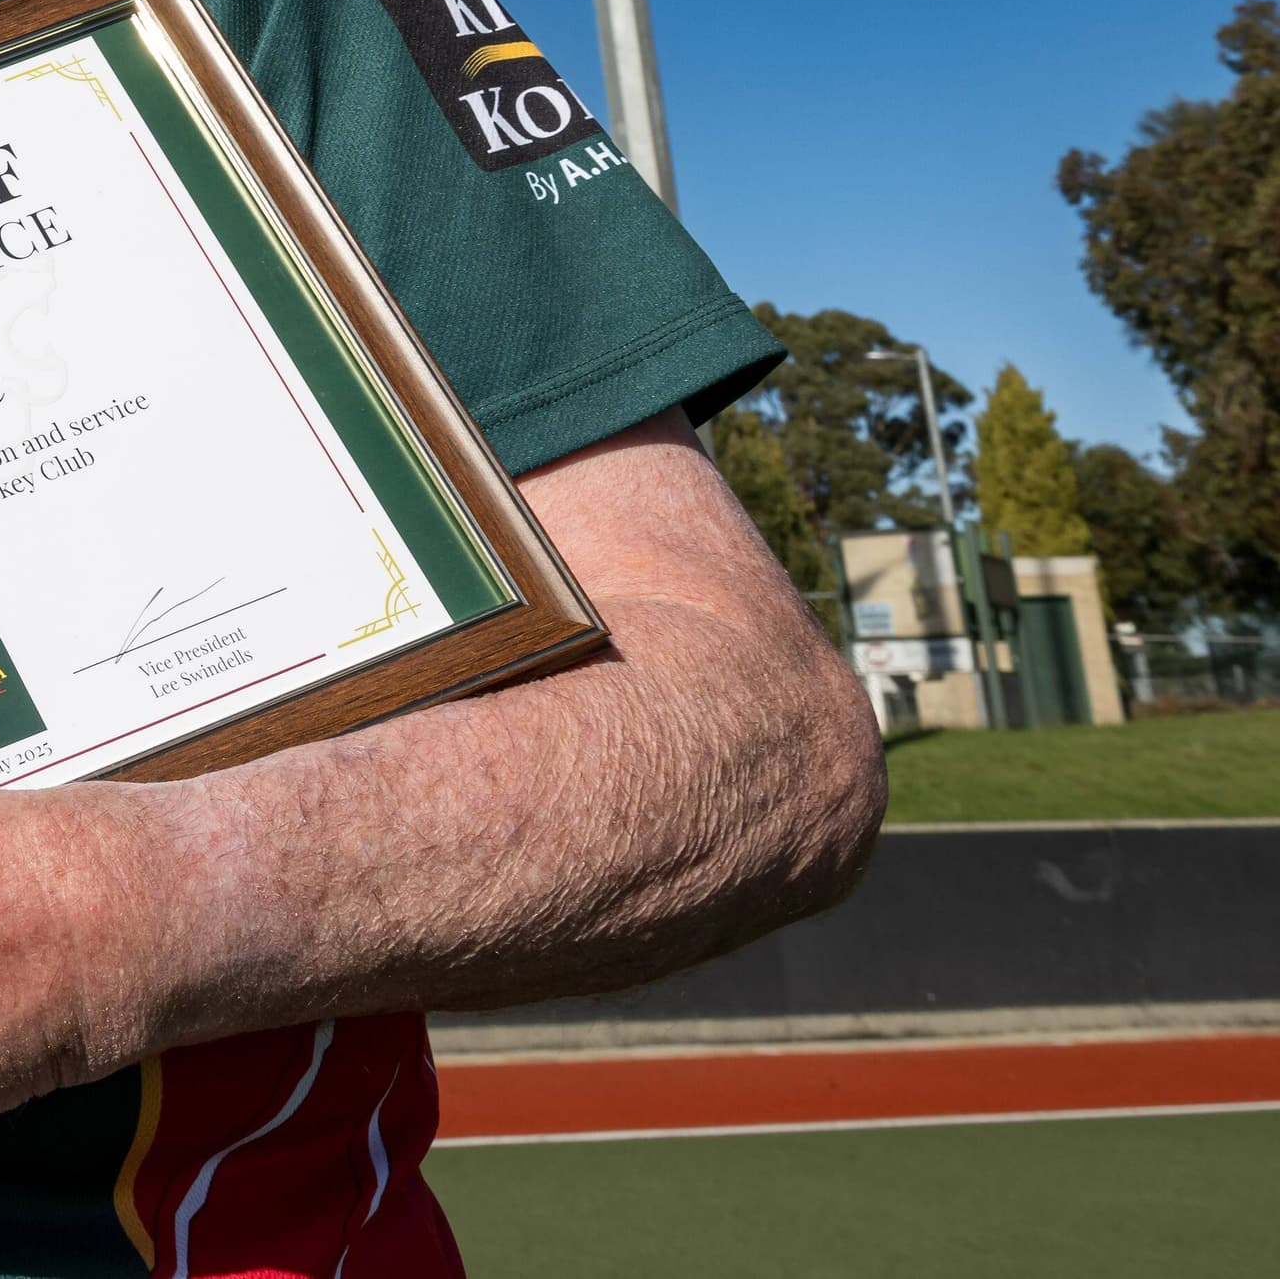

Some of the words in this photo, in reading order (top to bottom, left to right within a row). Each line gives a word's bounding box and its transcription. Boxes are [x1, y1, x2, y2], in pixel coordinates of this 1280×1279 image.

[525, 171, 560, 205] By
[21, 421, 67, 455] and
[68, 395, 149, 437] service
[40, 447, 95, 481] Club
[138, 659, 172, 677] Vice
[173, 627, 247, 665] President
[150, 680, 179, 698] Lee
[180, 649, 253, 687] Swindells
[16, 741, 54, 767] 2025
